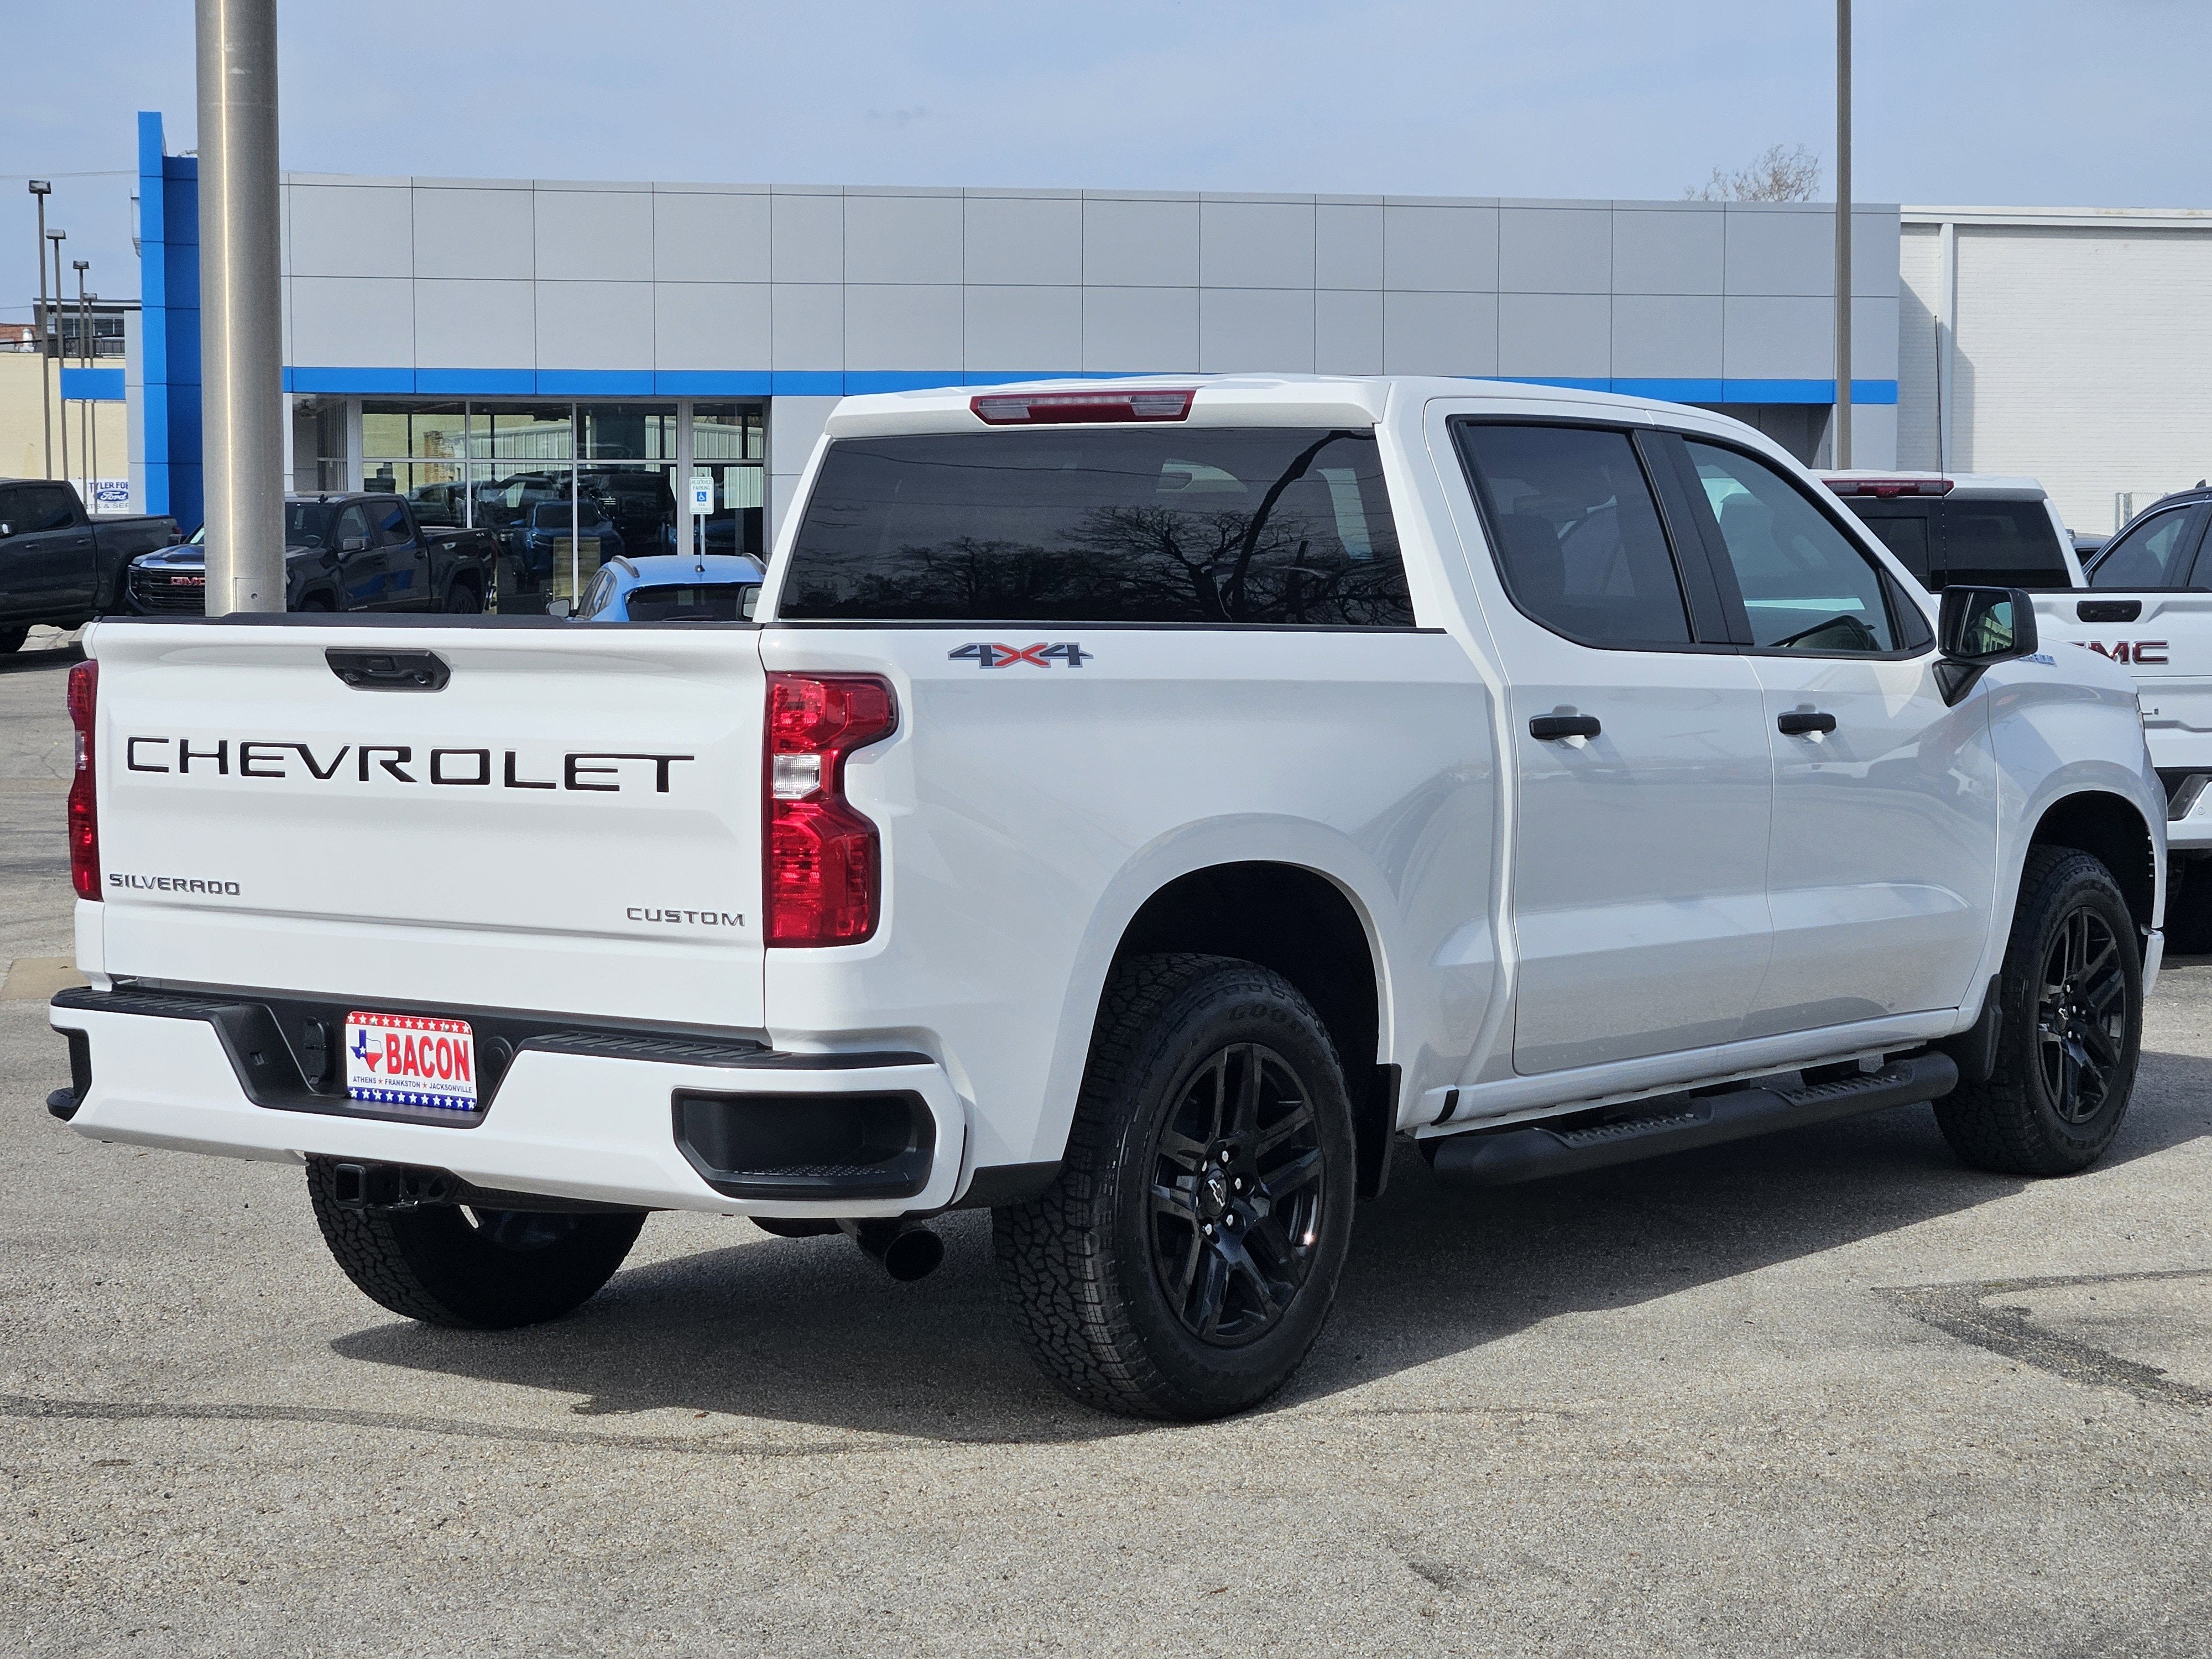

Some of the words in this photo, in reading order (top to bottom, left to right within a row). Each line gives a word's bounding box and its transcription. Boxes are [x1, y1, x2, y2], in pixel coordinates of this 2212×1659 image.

[100, 491, 127, 500] Ford
[170, 577, 206, 585] GMC
[2066, 640, 2169, 665] MC
[127, 737, 695, 793] CHEVROLET
[109, 873, 241, 895] SILVERADO
[627, 907, 745, 927] CUSTOM
[385, 1033, 471, 1082] BACON
[353, 1076, 377, 1084] ATHENS
[385, 1078, 420, 1088] FRANKSTON
[429, 1083, 472, 1093] JACKSONVILLE
